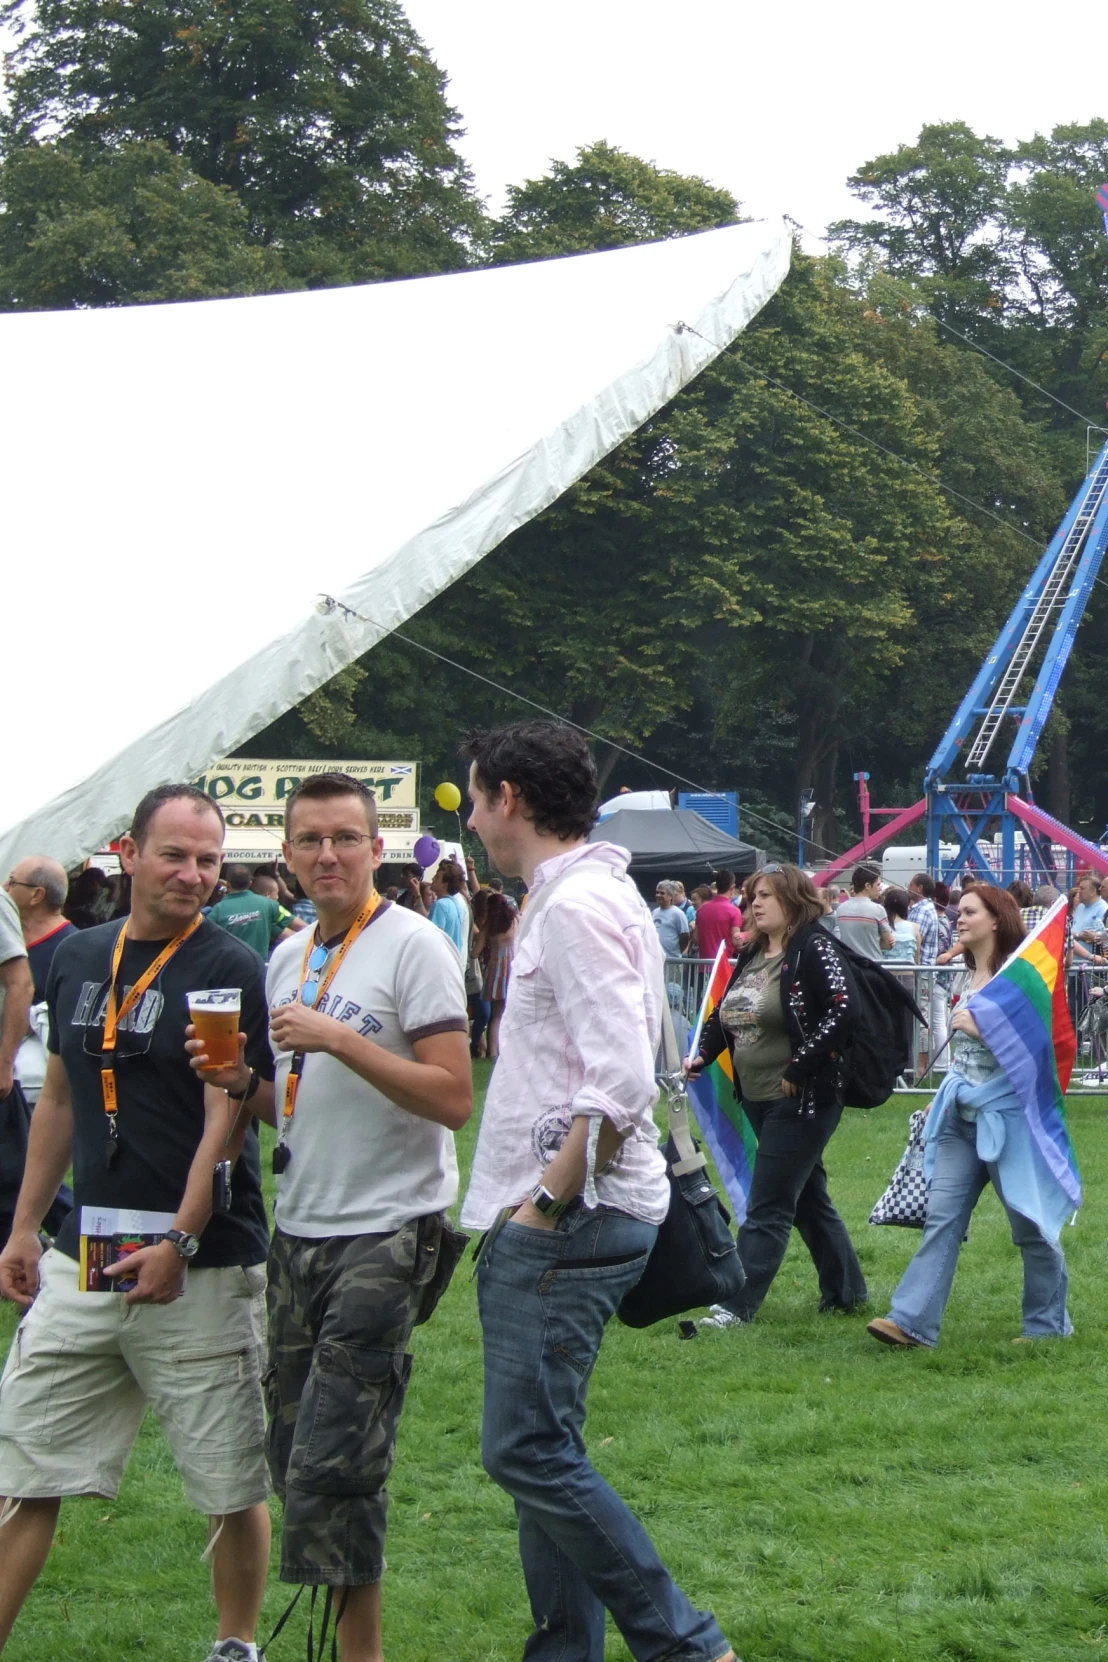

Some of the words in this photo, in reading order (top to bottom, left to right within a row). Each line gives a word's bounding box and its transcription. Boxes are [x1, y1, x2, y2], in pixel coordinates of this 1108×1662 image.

[216, 763, 241, 772] QUALITY
[243, 763, 267, 772] BRITISH
[276, 764, 306, 773] SCOTTISH
[346, 766, 368, 774] SERVED
[370, 766, 385, 774] HERE
[225, 813, 285, 827] CAR
